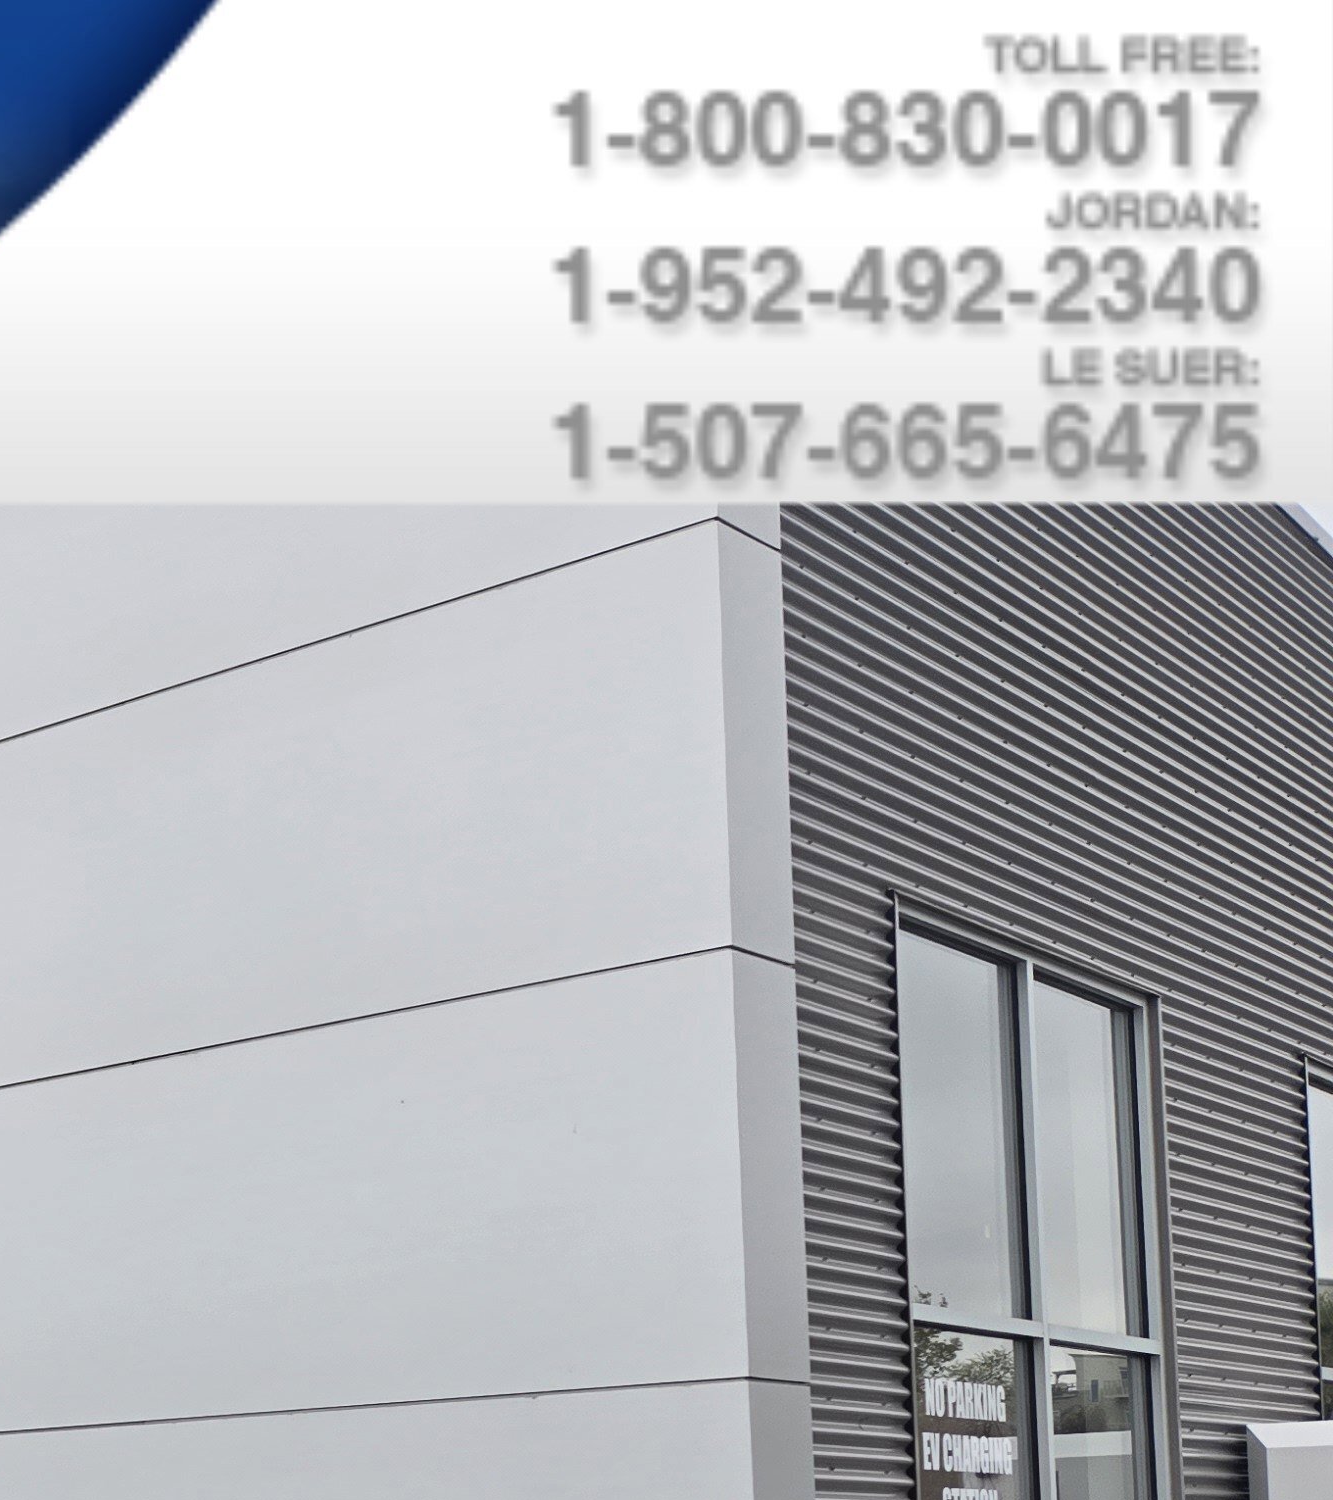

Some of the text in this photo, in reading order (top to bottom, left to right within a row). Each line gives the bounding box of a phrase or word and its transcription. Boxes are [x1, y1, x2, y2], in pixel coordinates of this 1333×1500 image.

[924, 1378, 1007, 1422] NO PARKING
[922, 1432, 1013, 1475] EV CHARGING
